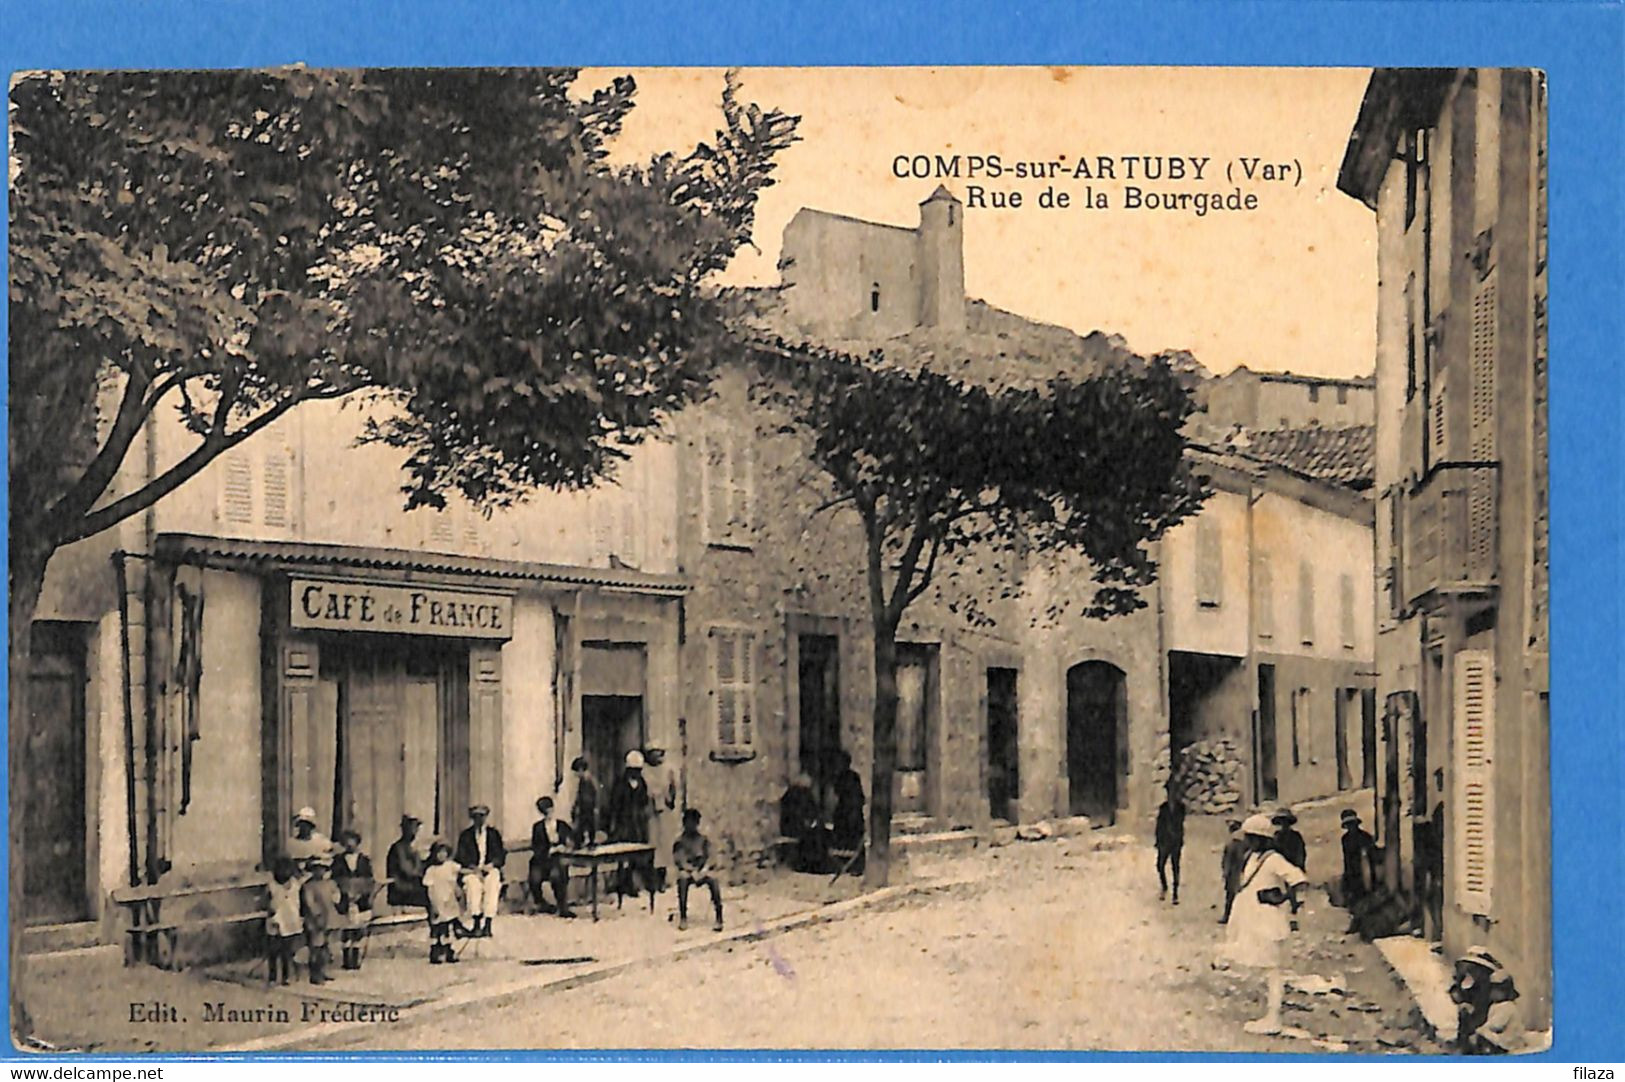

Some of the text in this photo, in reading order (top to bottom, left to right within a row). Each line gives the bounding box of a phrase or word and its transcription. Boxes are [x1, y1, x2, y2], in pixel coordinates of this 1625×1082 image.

[301, 585, 503, 629] CAFÉ de FRANCE
